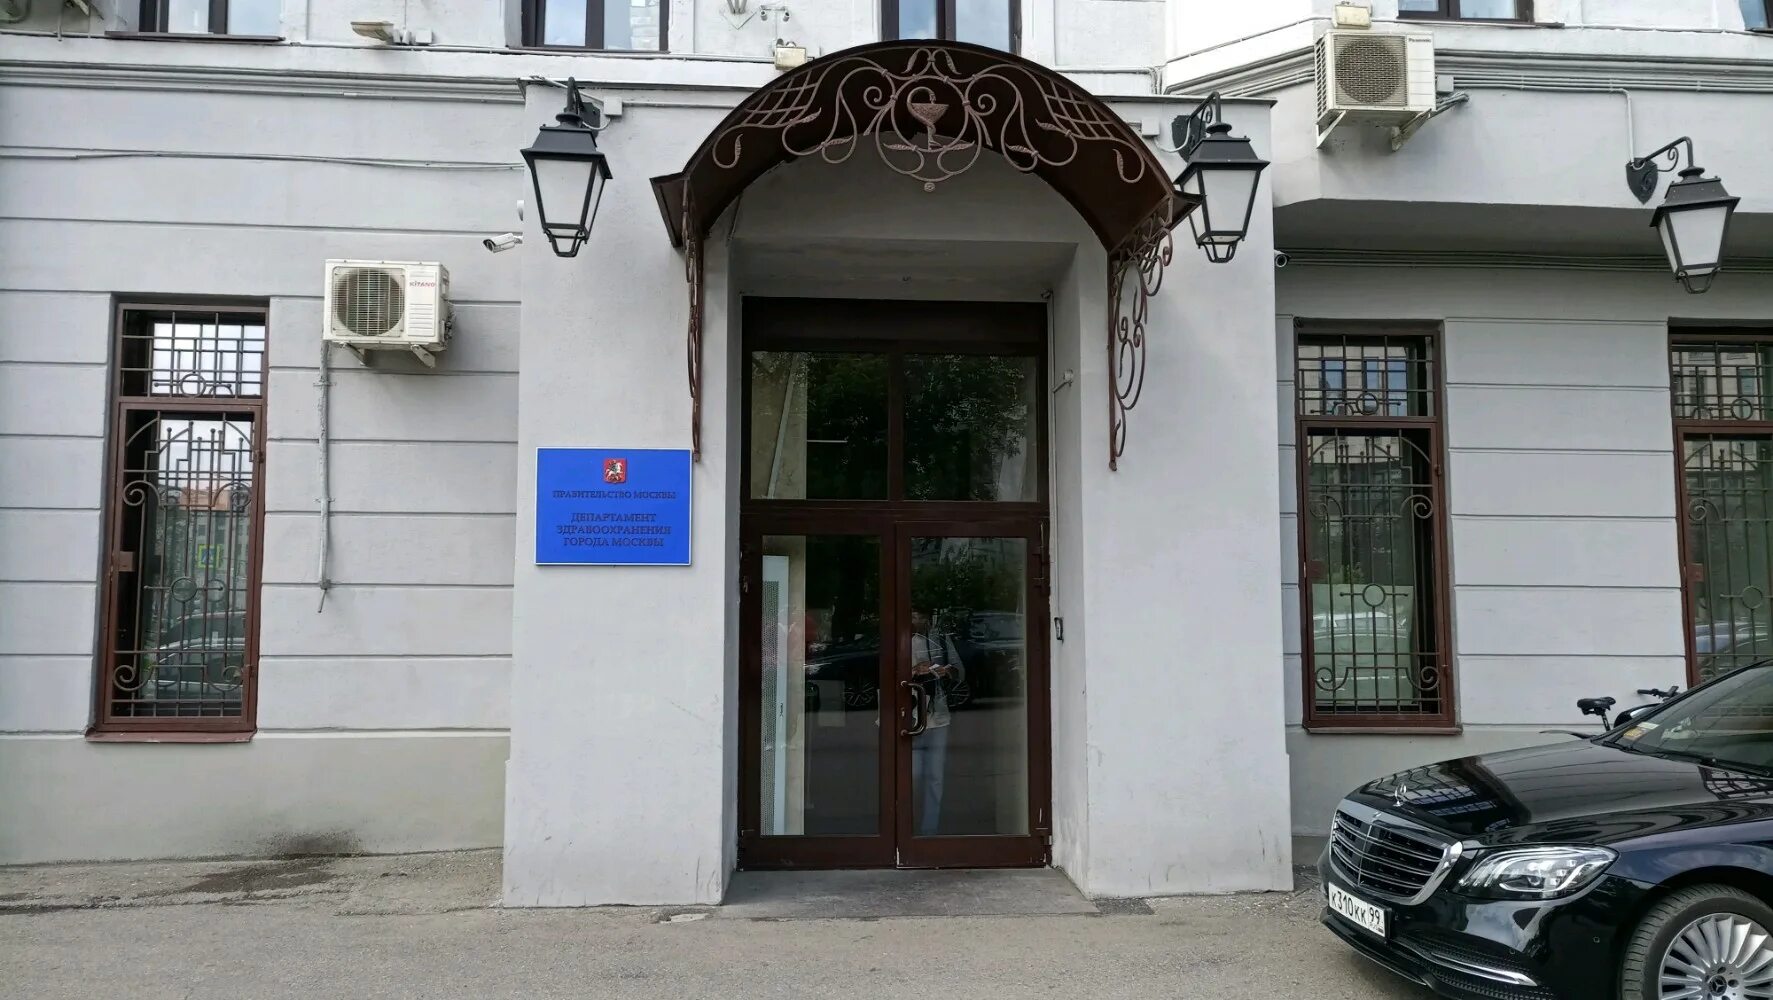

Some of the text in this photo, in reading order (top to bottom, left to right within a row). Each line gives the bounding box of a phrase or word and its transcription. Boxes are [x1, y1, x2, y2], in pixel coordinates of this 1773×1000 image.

[552, 490, 676, 499] ПРАВИТЕЛЬСТВО МОСКВЫ
[571, 513, 656, 523] ДЕПАРТАМЕНТ
[556, 525, 672, 535] ЗДРАВООХРАНЕНИЯ
[563, 537, 664, 547] ГОРОДА МОСКВЫ
